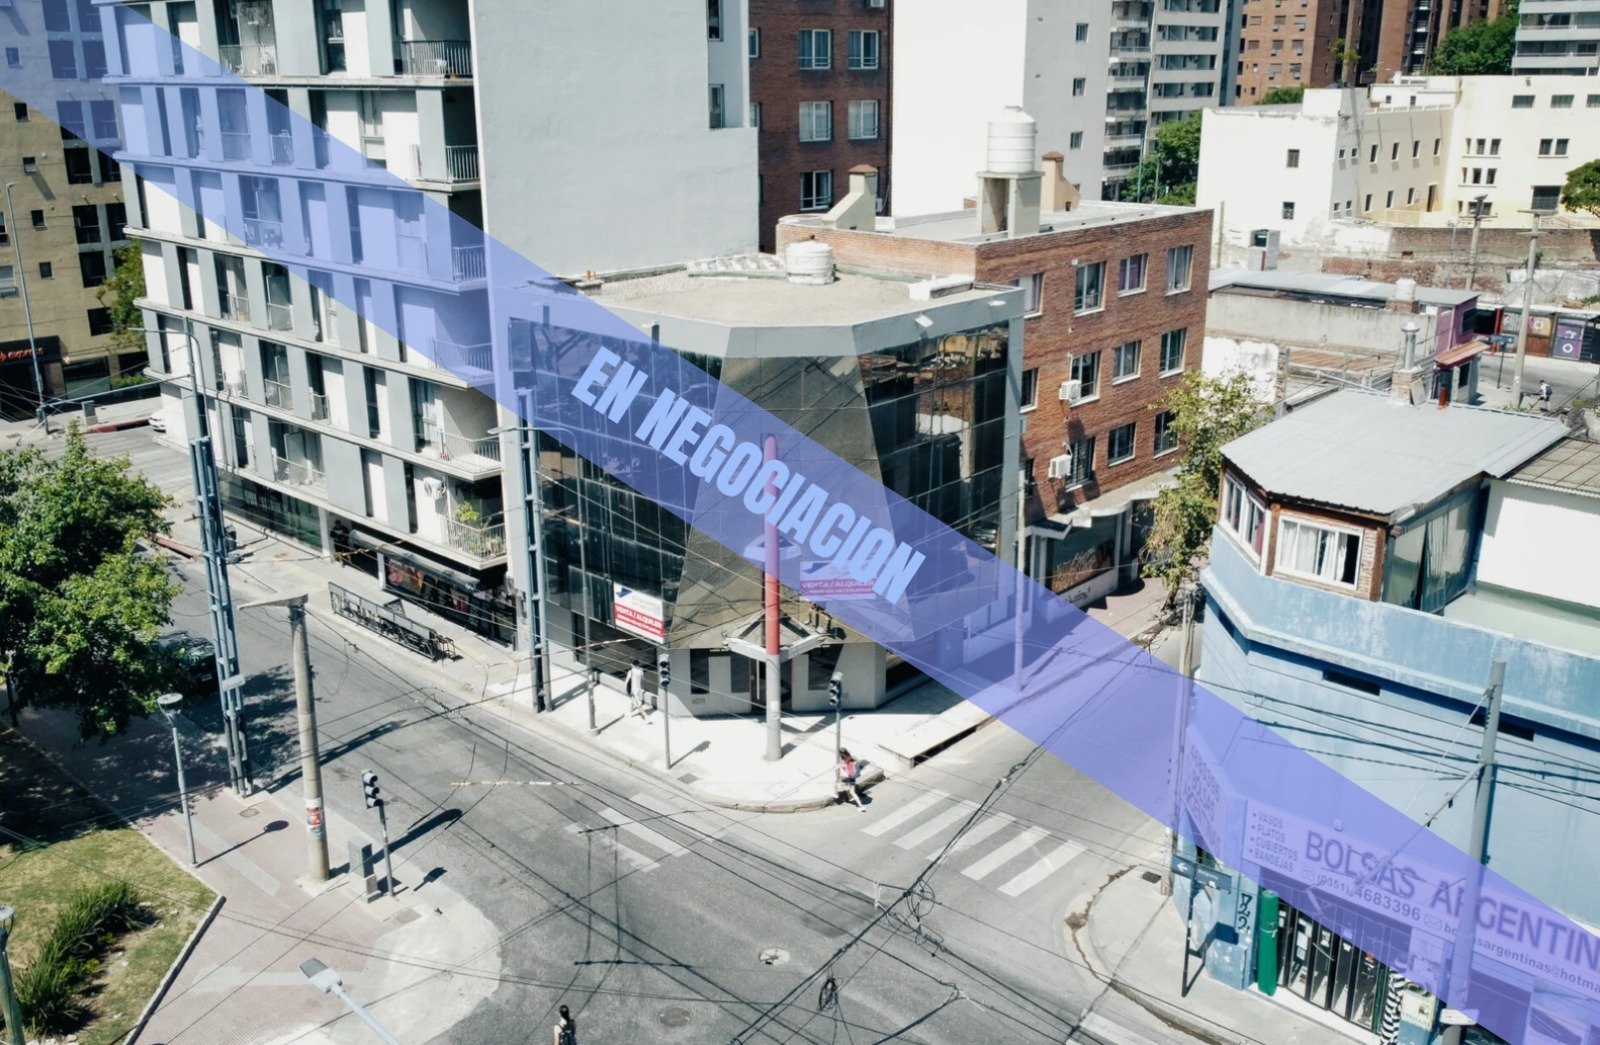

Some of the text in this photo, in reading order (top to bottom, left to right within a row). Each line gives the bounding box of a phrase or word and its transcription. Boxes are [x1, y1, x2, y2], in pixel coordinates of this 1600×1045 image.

[1258, 813, 1284, 830] VASOS
[1256, 825, 1286, 844] PLATOS
[1254, 848, 1295, 873] BANDEJAS
[1255, 836, 1299, 862] CUBIERTOS
[1305, 830, 1416, 899] BOLSAS
[1354, 886, 1422, 922] 4683396
